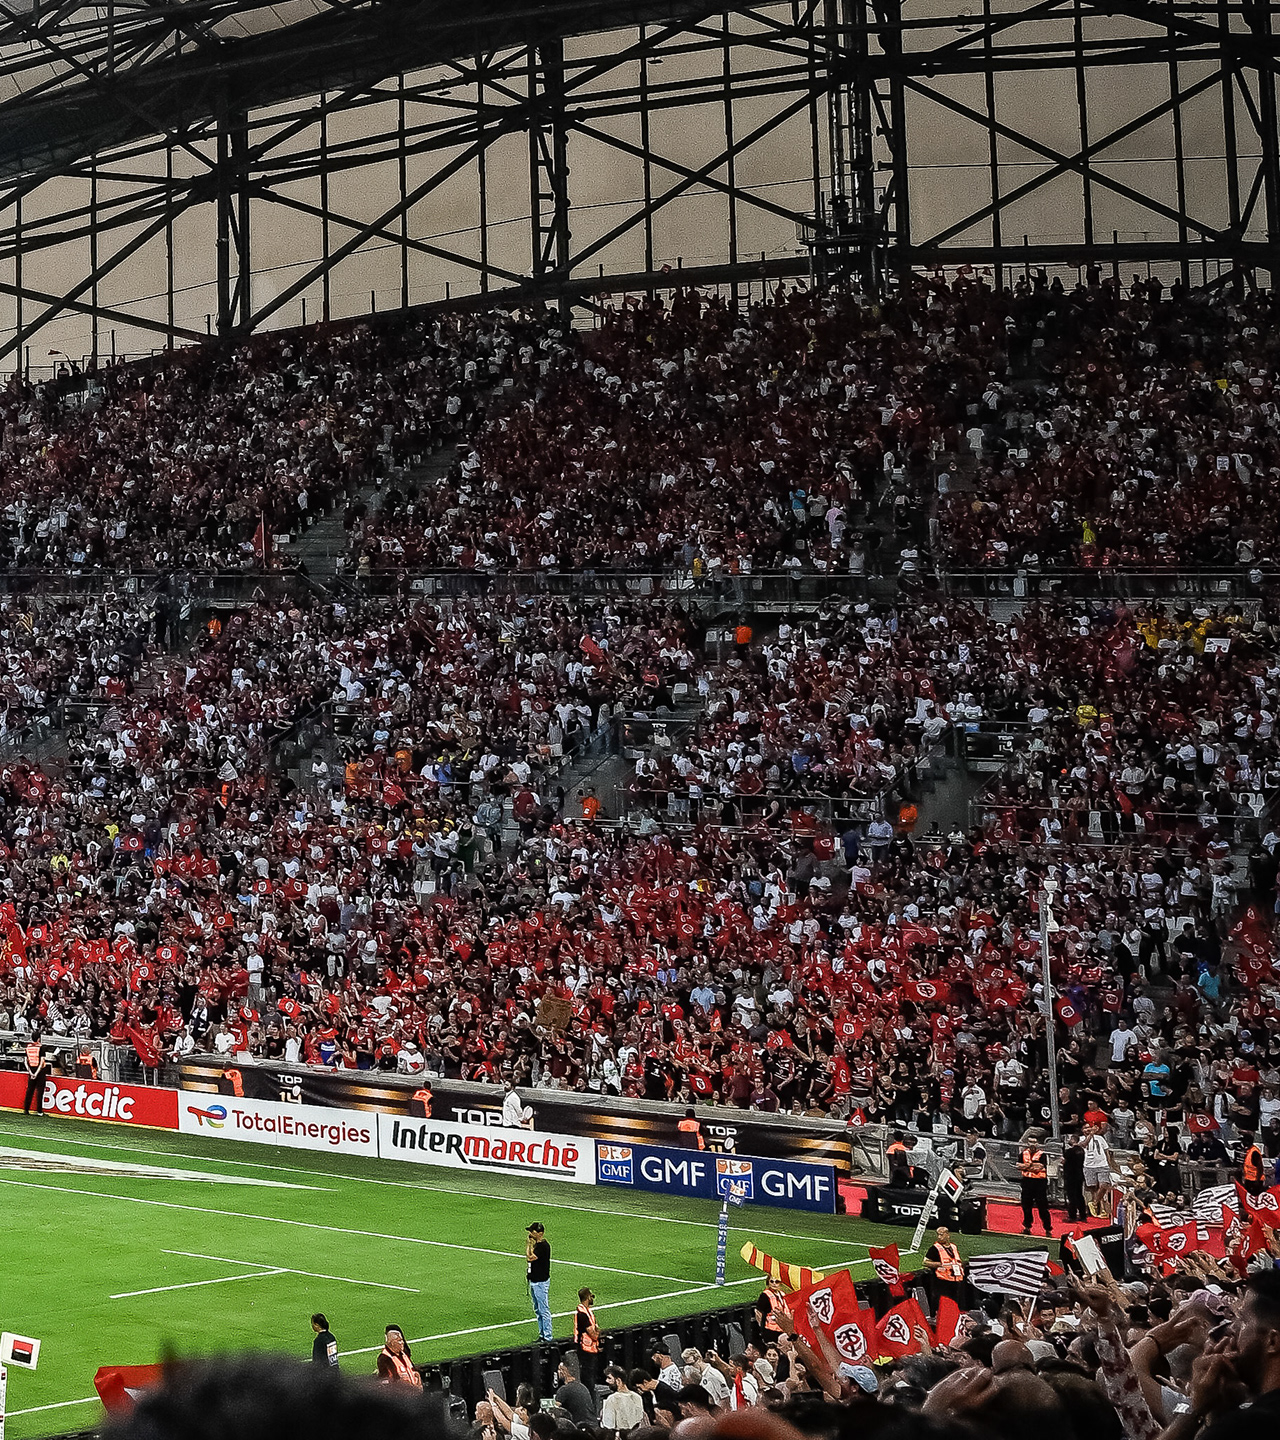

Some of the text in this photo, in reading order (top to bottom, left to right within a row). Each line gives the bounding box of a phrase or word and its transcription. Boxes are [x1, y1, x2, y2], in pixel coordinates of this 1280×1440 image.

[277, 1074, 303, 1084] TOP
[42, 1080, 136, 1120] Betclic
[232, 1109, 370, 1145] TotalEnergies
[706, 1125, 737, 1136] TOP
[601, 1163, 631, 1179] GMF
[640, 1156, 705, 1187] GMF
[761, 1170, 829, 1202] GMF
